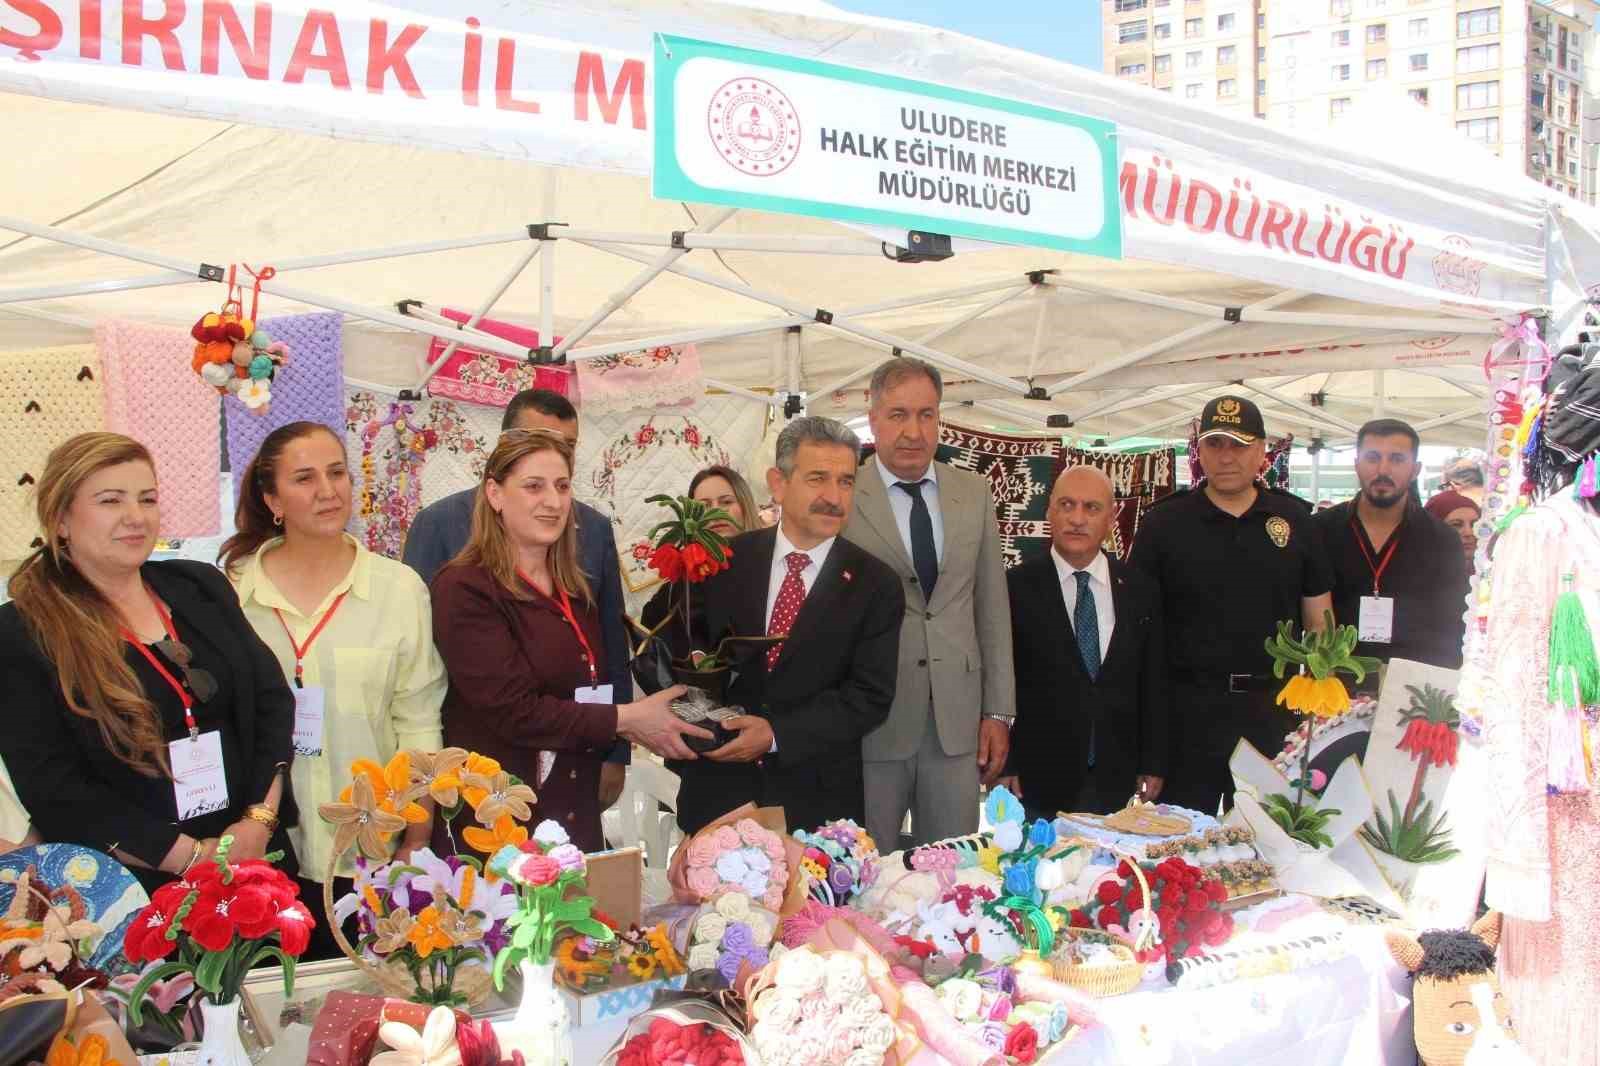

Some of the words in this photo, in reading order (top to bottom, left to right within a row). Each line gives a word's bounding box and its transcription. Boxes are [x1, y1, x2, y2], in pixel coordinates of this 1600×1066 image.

[461, 16, 542, 114] İL
[900, 107, 1007, 147] ULUDERE
[820, 127, 889, 160] HALK
[894, 137, 977, 174] EĞİTİM
[982, 154, 1076, 192] MERKEZİ
[878, 170, 1031, 216] MÜDÜRLÜĞÜ
